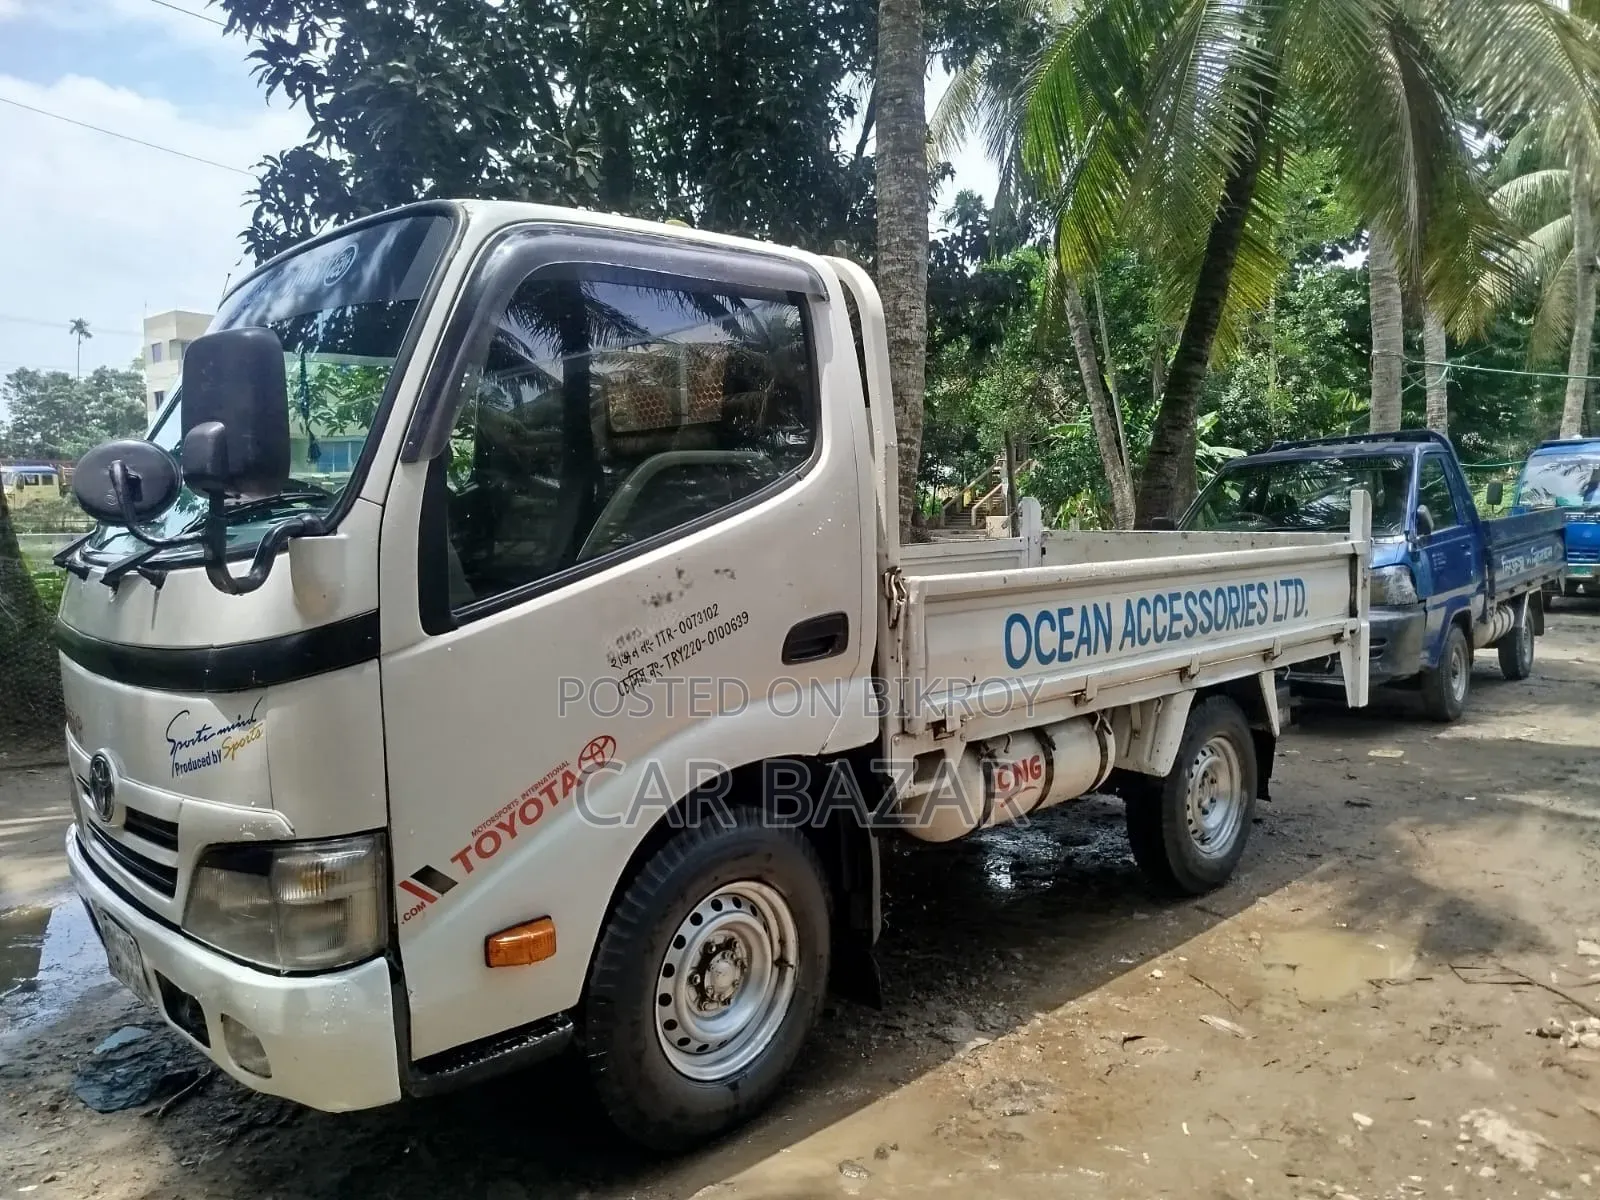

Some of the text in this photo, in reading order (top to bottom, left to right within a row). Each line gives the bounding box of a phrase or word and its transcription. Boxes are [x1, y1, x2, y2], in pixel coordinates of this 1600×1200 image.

[1004, 577, 1309, 670] OCEAN ACCESSORIES LTD.
[174, 723, 264, 776] Produced by Sports
[997, 755, 1042, 789] CNG
[450, 769, 583, 874] TOYOTA
[471, 760, 571, 838] MOTORSPORTS INTERNATIONAL
[401, 900, 427, 925] .COM
